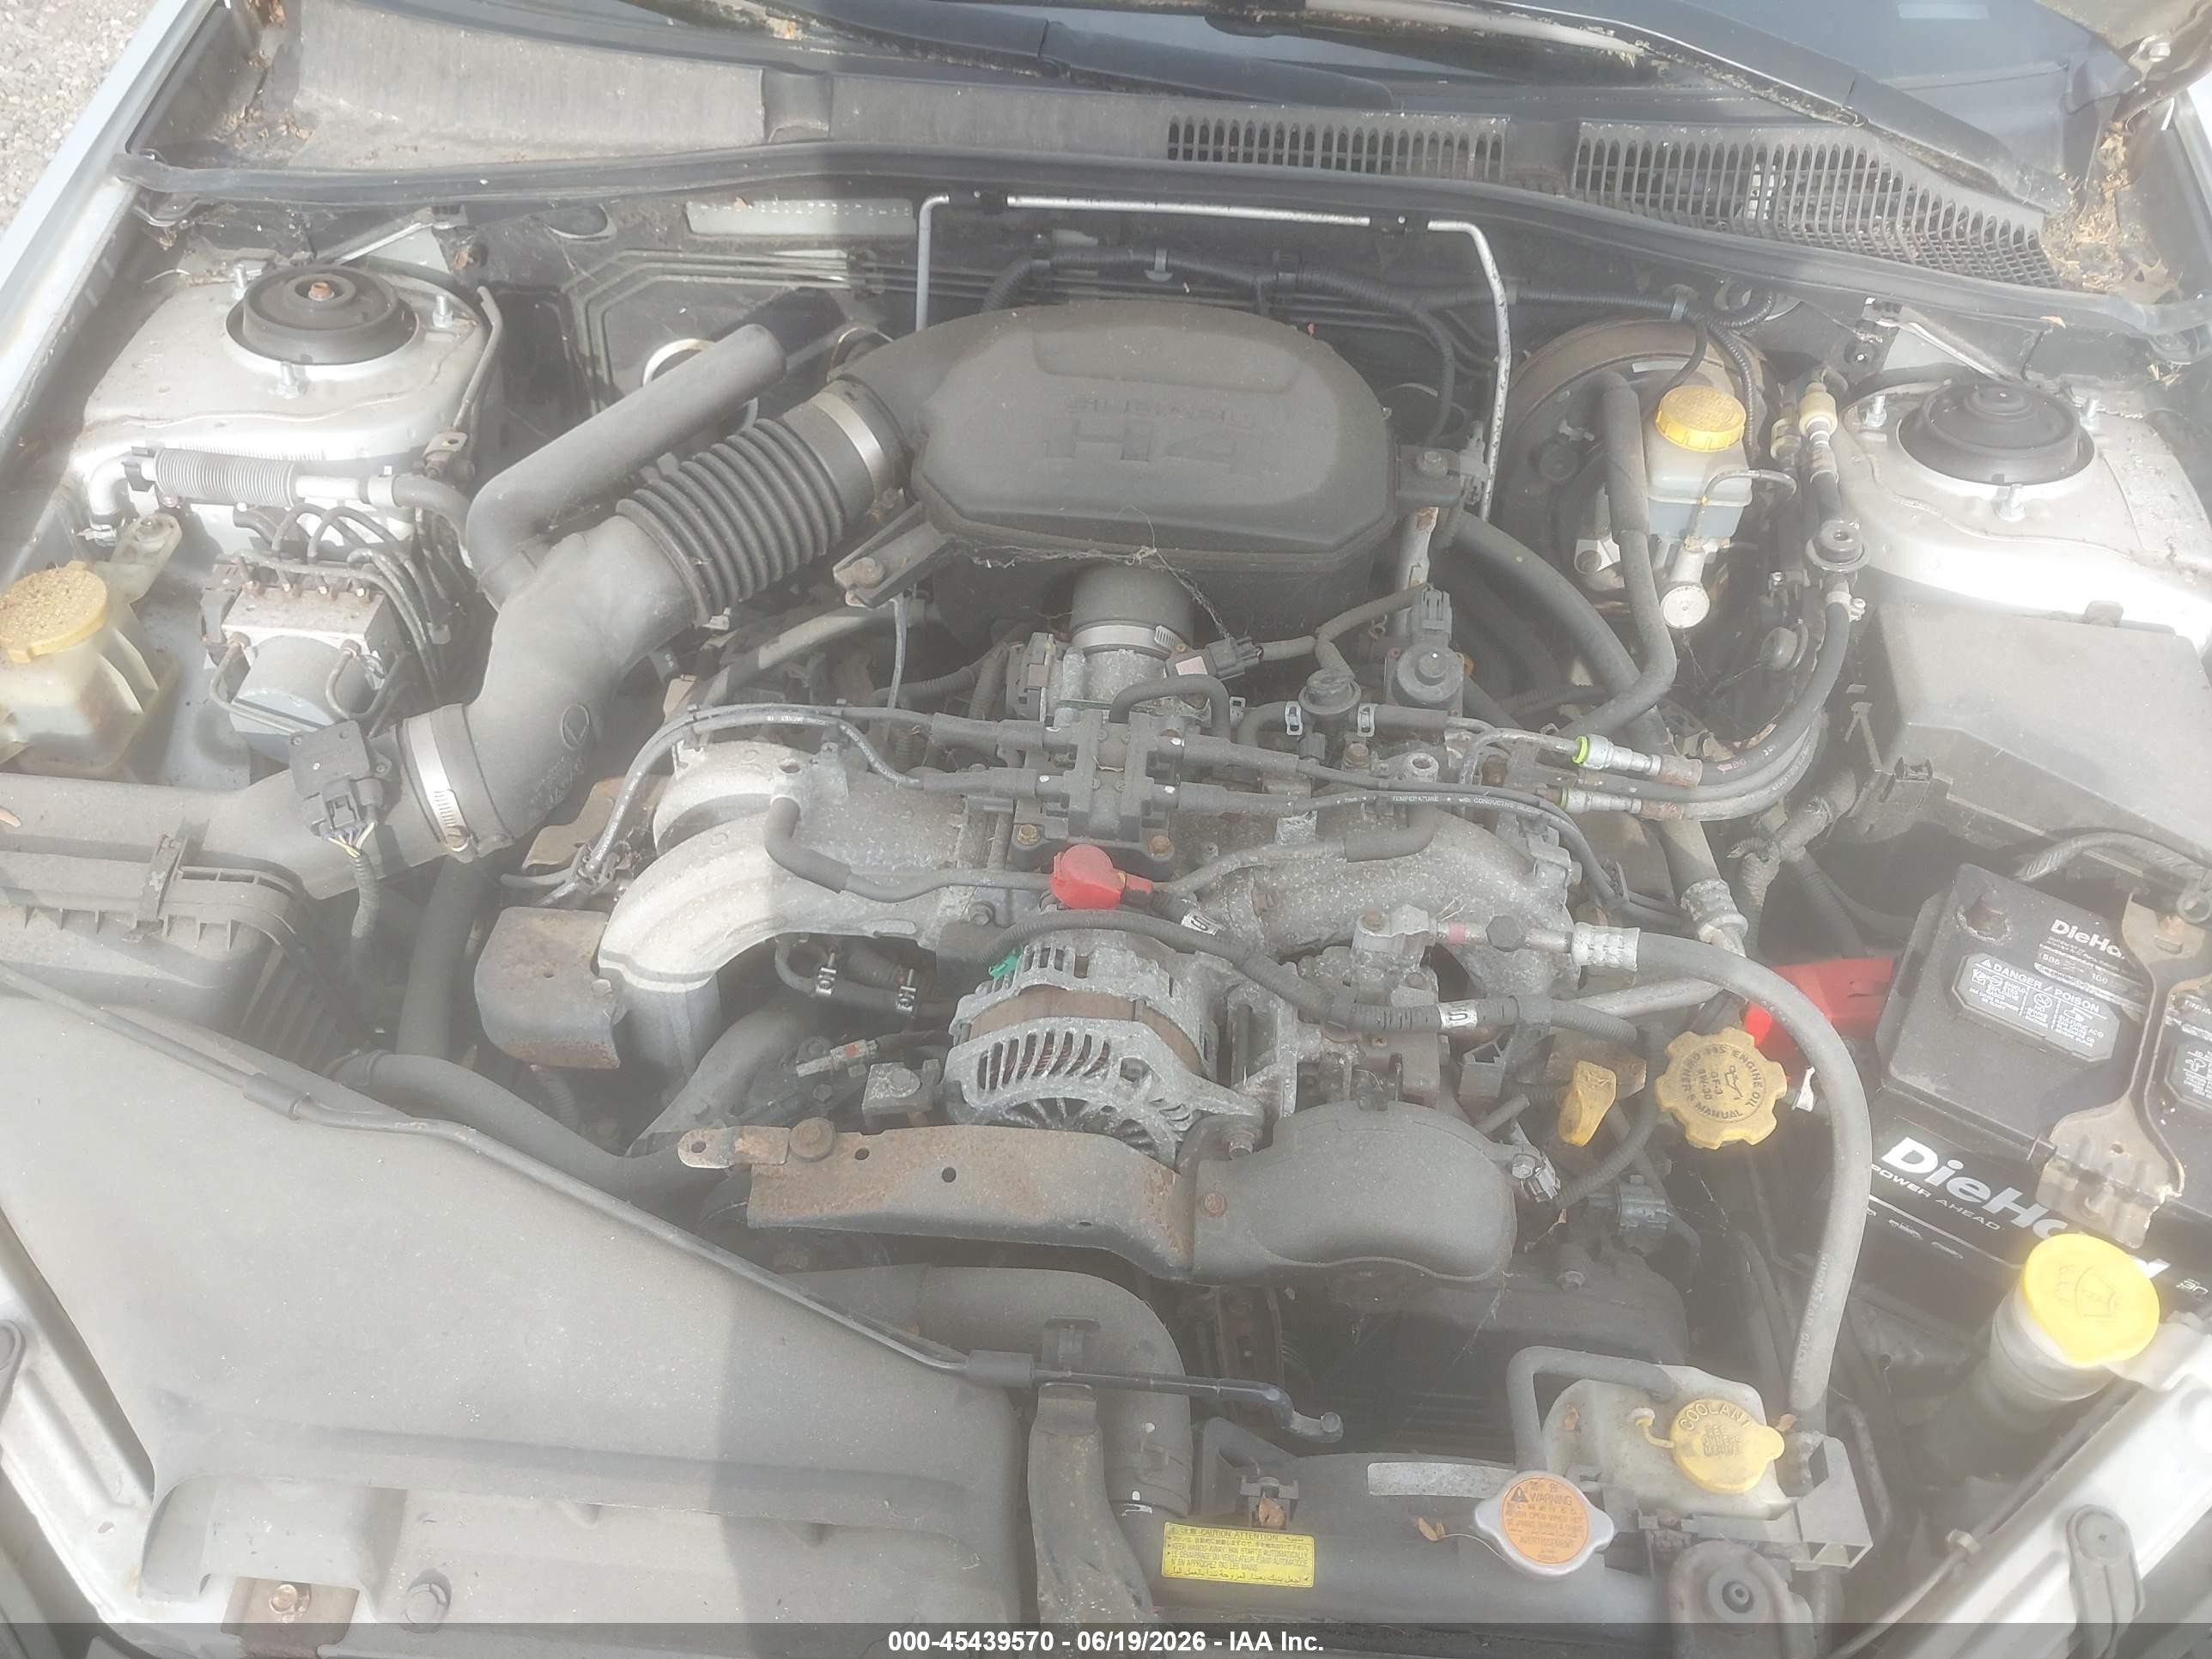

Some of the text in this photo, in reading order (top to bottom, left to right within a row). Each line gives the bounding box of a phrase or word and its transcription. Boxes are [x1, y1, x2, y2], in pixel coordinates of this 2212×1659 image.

[1993, 963, 2043, 989] DANGER
[2053, 989, 2100, 1012] POISON
[2088, 1029, 2104, 1038] ACID
[1730, 1050, 1763, 1108] ENGINE OIL
[1695, 1103, 1744, 1120] MANUAL
[1870, 1164, 2002, 1231] POWER AHEAD
[1679, 1402, 1753, 1430] COOLANT
[1530, 1492, 1572, 1505] WARNING
[1200, 1528, 1278, 1540] CAUTION ATTENTION
